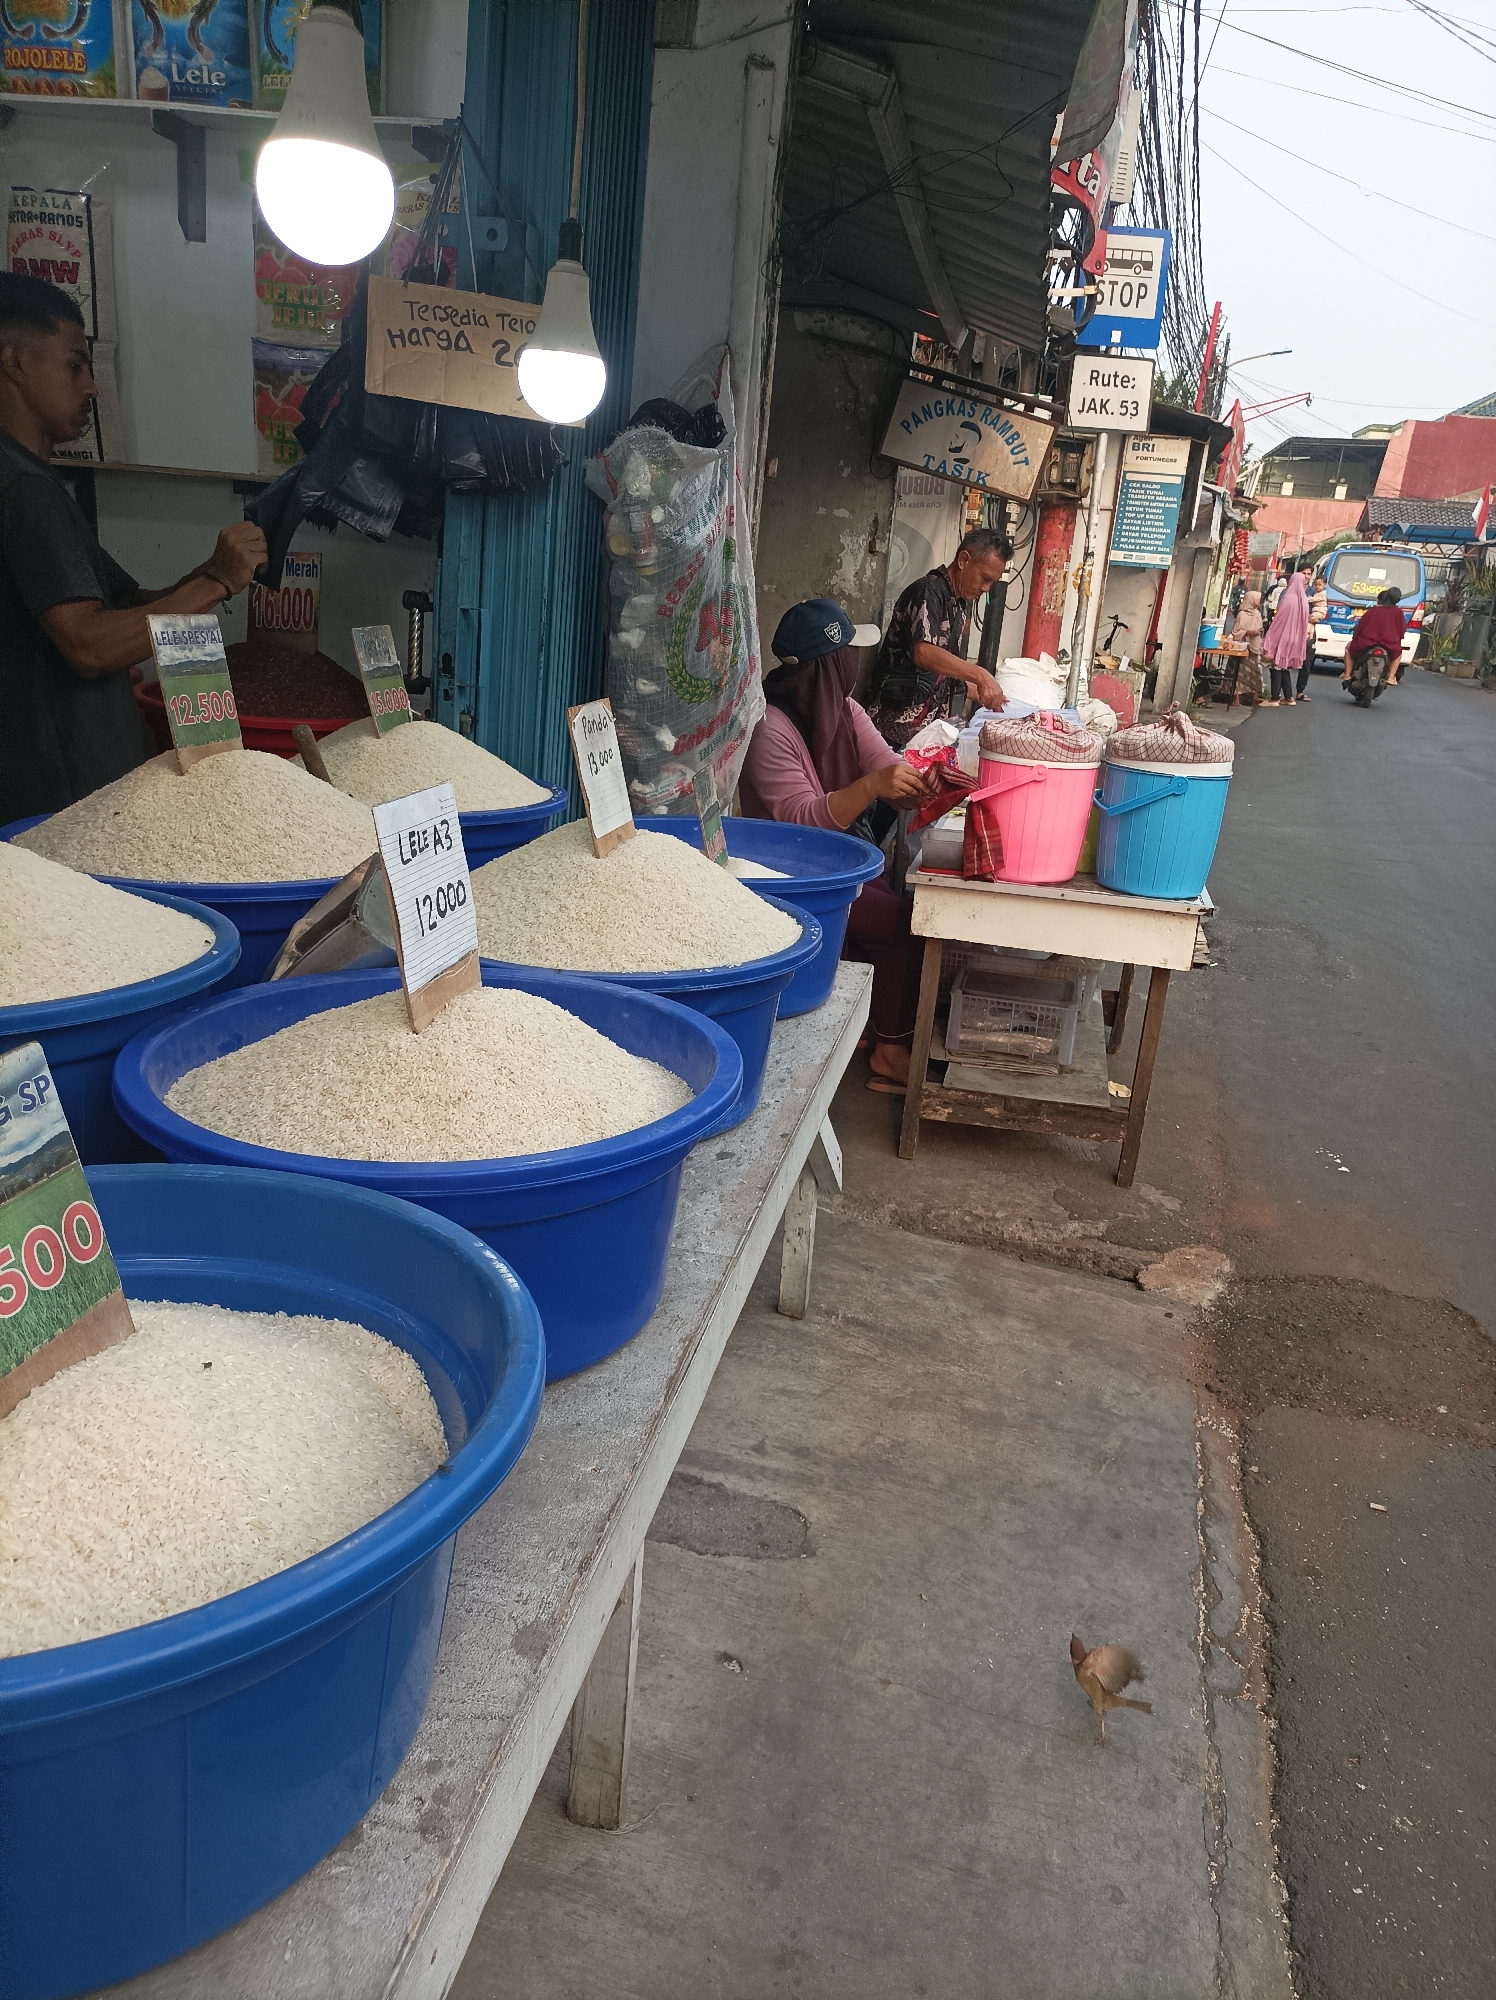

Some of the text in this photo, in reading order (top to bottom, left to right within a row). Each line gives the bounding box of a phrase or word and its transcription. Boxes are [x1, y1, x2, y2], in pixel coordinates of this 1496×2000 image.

[4, 46, 87, 74] ROJOLELE
[171, 62, 227, 87] Lele
[12, 195, 73, 210] KEPALA
[39, 212, 84, 228] RAMOS
[12, 257, 80, 284] BMW
[1096, 279, 1148, 308] STOP
[403, 301, 537, 334] Tersedia Telo
[1089, 369, 1136, 389] Rute:
[1078, 397, 1140, 417] JAK. 53
[900, 399, 1030, 467] PANGKAS RAMBUT
[922, 454, 990, 486] TASIK
[285, 557, 319, 578] Merah
[253, 584, 315, 630] 16.000
[155, 628, 223, 646] LELE SPESIAL
[170, 690, 237, 726] 12.500
[587, 748, 614, 776] 13.000
[398, 819, 453, 865] LELE A3
[18, 1073, 51, 1114] SP
